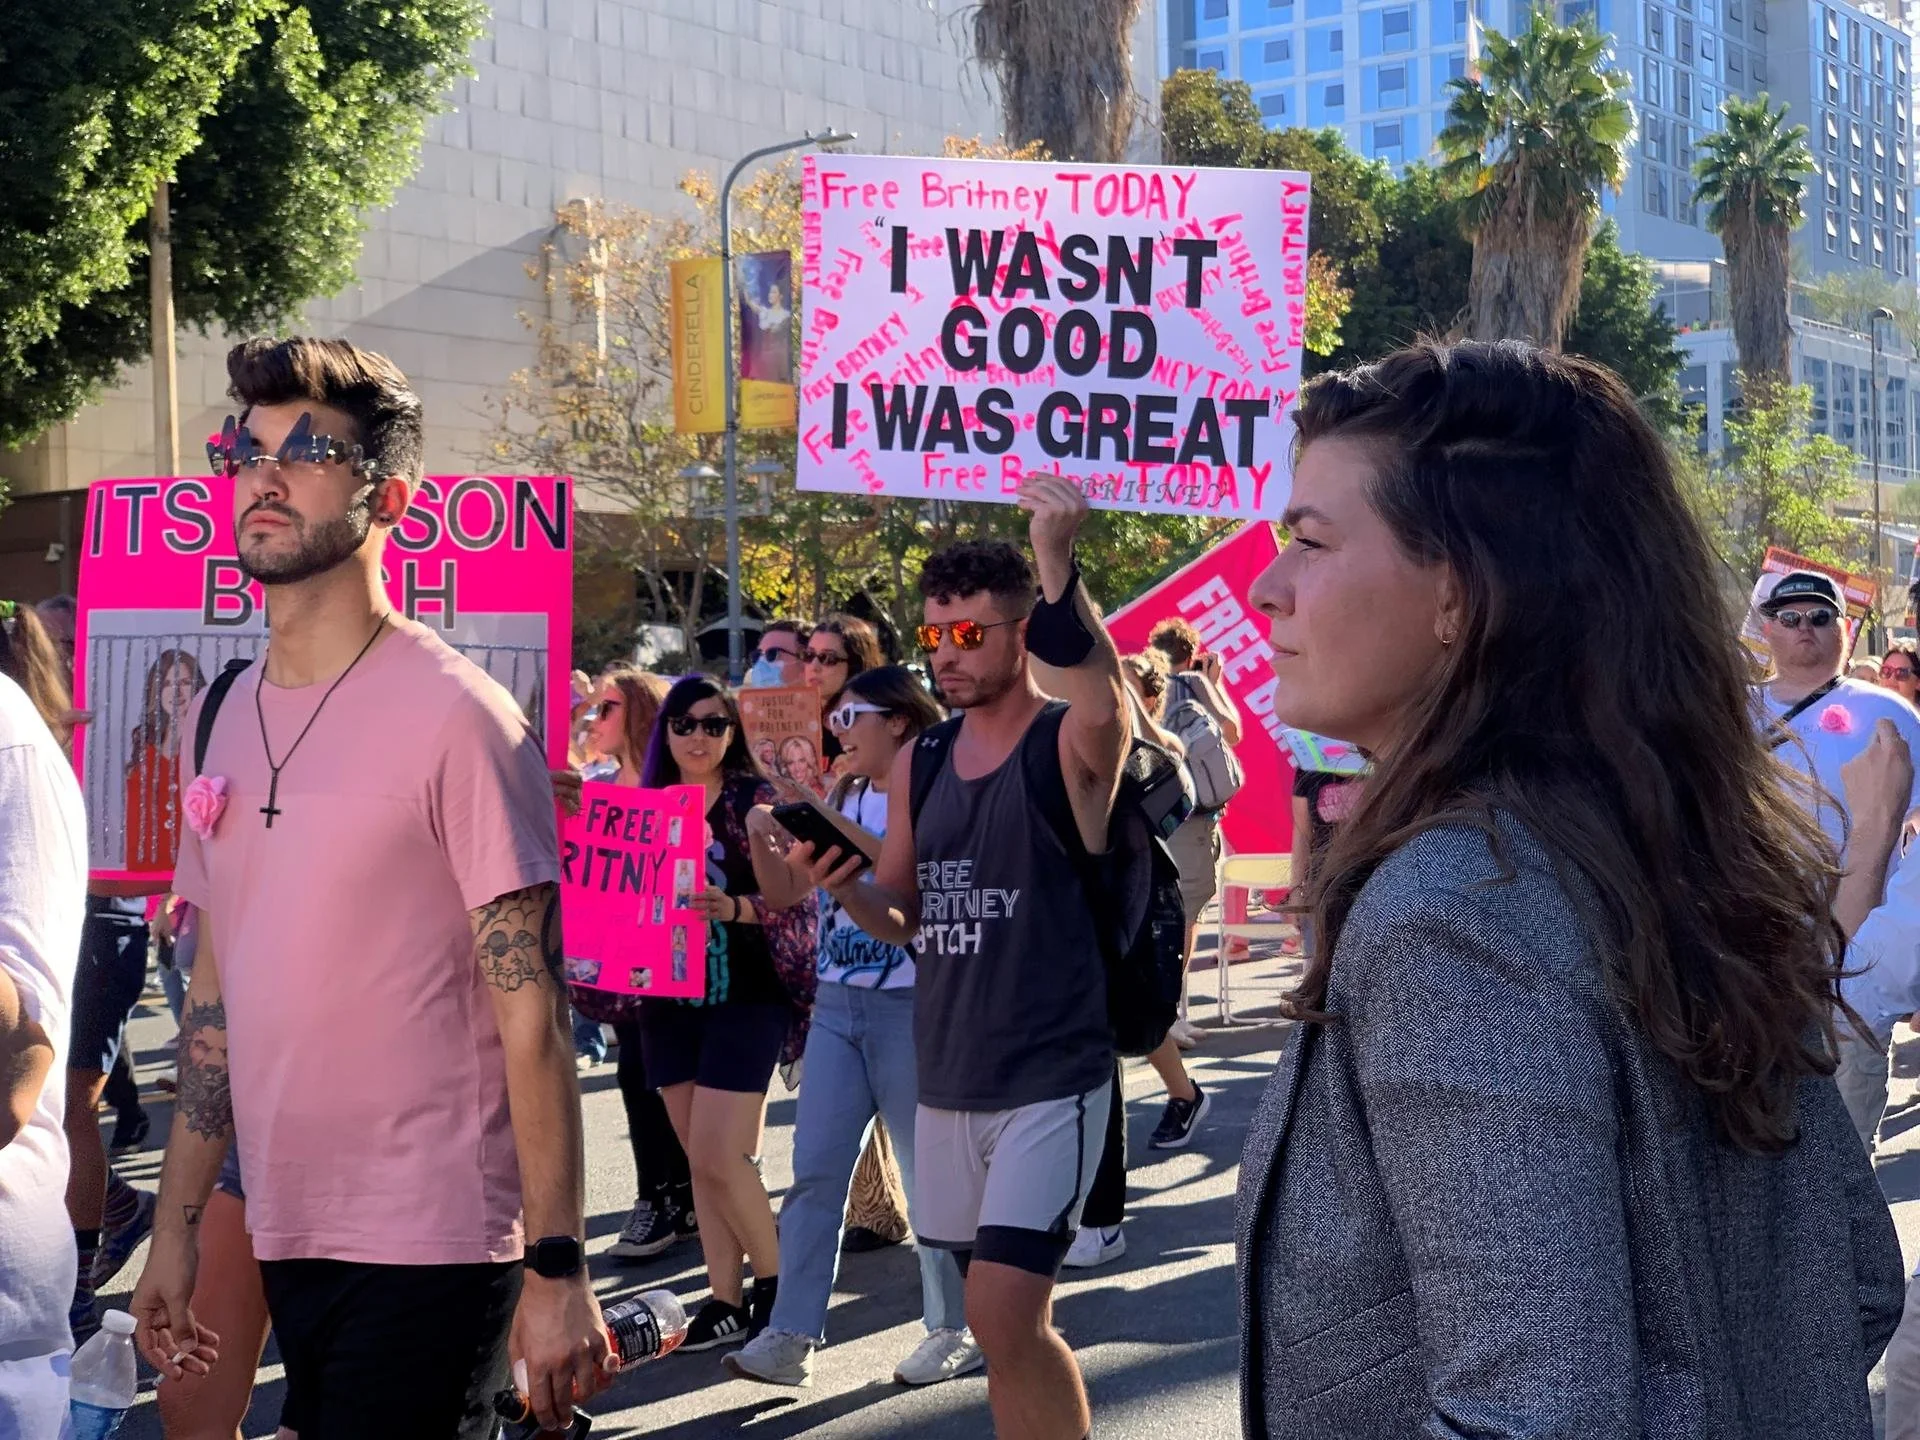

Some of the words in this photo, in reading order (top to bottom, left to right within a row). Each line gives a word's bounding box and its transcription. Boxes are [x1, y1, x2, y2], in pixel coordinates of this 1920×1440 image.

[820, 172, 899, 209] Free
[921, 172, 1048, 220] Britney
[1055, 172, 1197, 221] TODAY
[685, 273, 704, 416] CINDERELLA
[940, 305, 1158, 380] GOOD
[831, 383, 848, 449] I
[871, 383, 1015, 454] WAS
[923, 453, 987, 491] Free
[90, 479, 216, 558] ITS
[586, 798, 656, 845] FREE
[561, 840, 667, 895] RITNY
[916, 859, 974, 890] FREE
